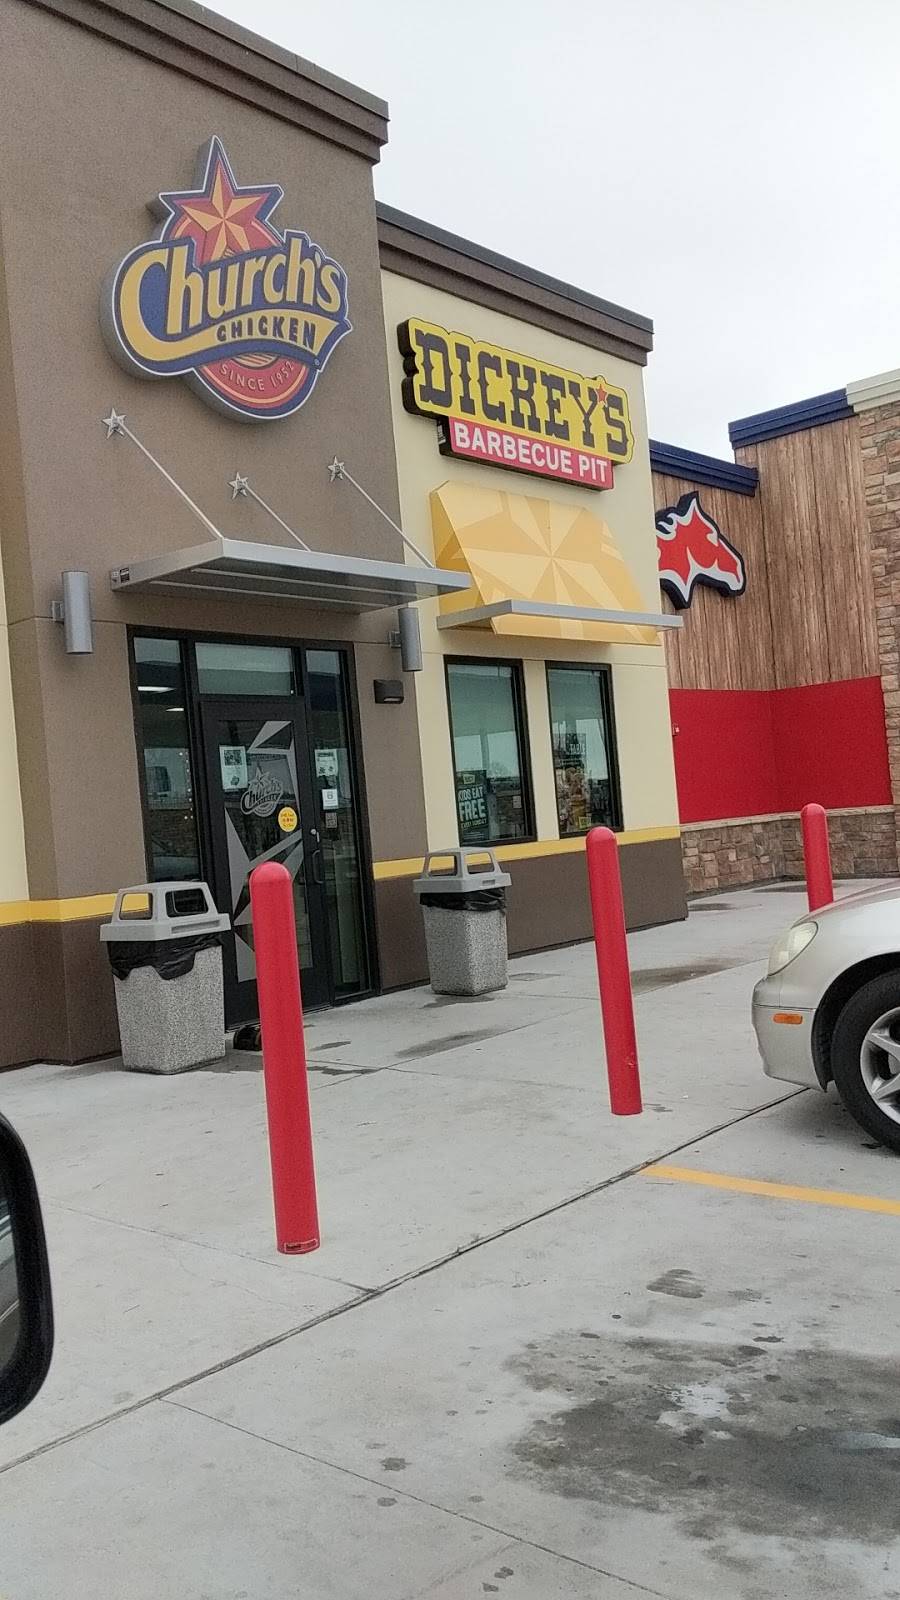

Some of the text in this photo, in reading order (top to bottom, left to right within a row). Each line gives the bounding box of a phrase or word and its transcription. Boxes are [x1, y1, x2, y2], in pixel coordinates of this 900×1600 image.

[119, 237, 341, 361] Church's
[216, 315, 316, 351] CHICKEN
[220, 360, 295, 391] SINCE 1952
[453, 422, 573, 475] BARBECUE
[578, 457, 608, 483] PIT
[471, 785, 483, 799] EAT
[459, 798, 486, 821] FREE
